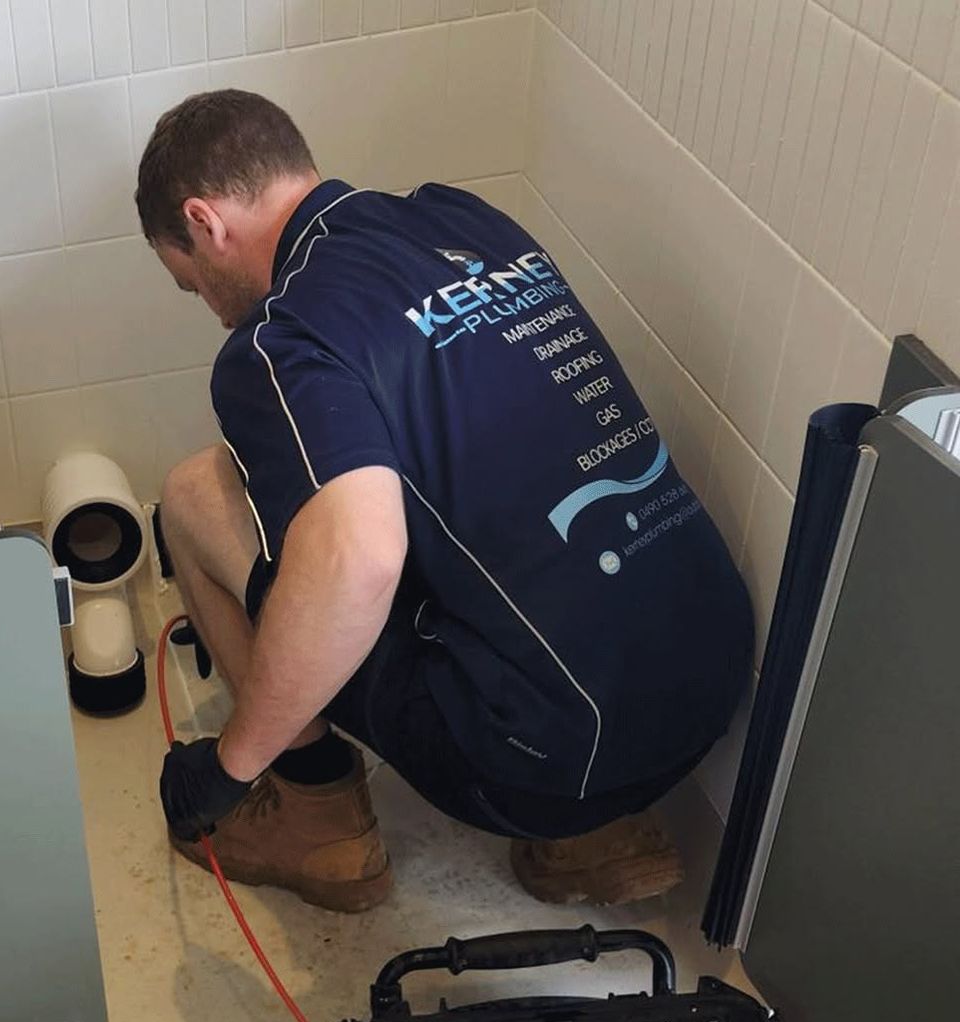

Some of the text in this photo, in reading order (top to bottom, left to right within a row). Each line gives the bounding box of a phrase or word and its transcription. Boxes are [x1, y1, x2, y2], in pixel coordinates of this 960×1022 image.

[533, 327, 589, 361] DRAINAGE
[551, 350, 603, 384] ROOFING
[573, 376, 614, 405] WATER
[596, 404, 622, 426] GAS
